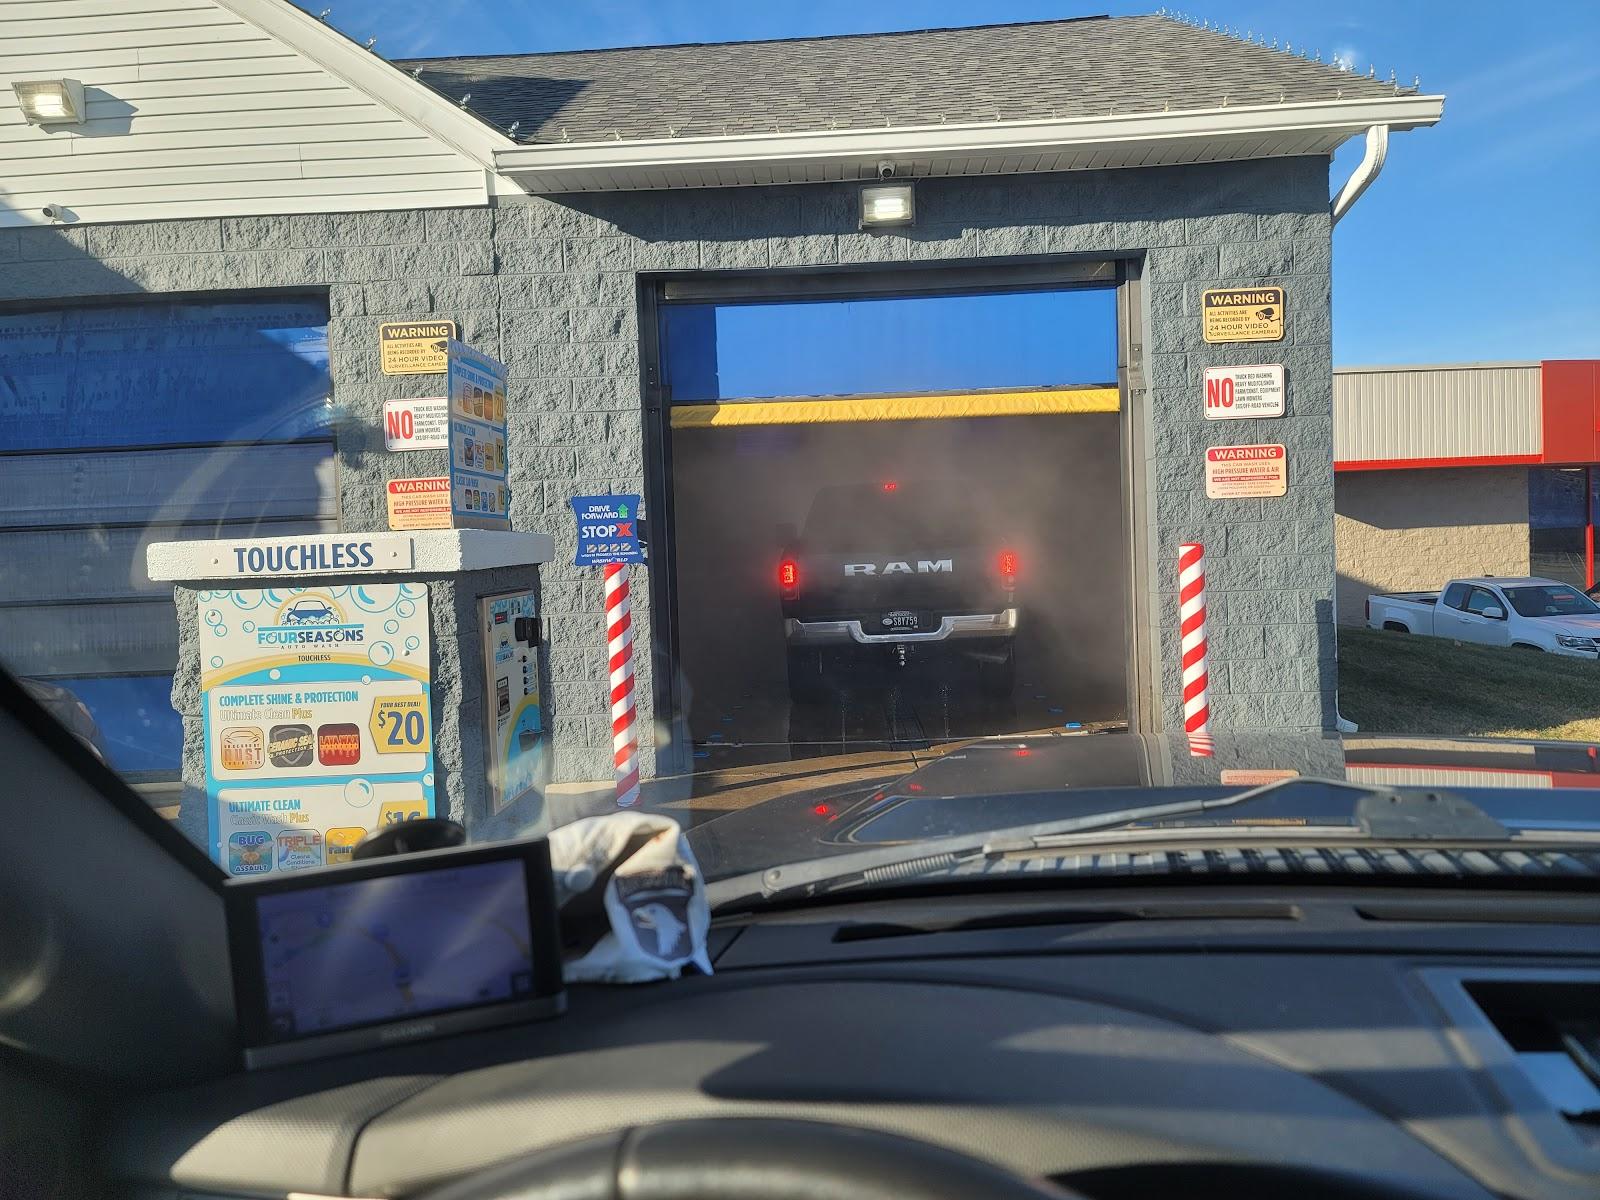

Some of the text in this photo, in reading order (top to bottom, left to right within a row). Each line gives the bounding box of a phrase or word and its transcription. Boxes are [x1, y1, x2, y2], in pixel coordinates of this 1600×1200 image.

[1211, 293, 1275, 305] WARNING
[387, 326, 448, 338] WARNING
[1207, 377, 1234, 408] NO
[387, 410, 413, 440] NO
[1215, 447, 1277, 460] WARNING
[1225, 467, 1249, 475] PRESSURE
[1249, 466, 1266, 474] WATER
[405, 499, 427, 507] PRESSURE
[588, 504, 610, 513] DRIVE
[581, 512, 618, 520] FORWARD
[581, 525, 617, 539] STOP
[234, 542, 374, 573] TOUCHLESS
[845, 559, 952, 577] RAM
[298, 654, 331, 662] TOUCHLESS
[219, 691, 359, 707] COMPLETE SHINE & PROTECTION
[219, 707, 313, 721] Ultimate Clean Plus
[378, 710, 424, 745] $20
[319, 734, 359, 746] LAVA WAX
[224, 748, 262, 761] RUST
[229, 799, 301, 813] ULTIMATE CLEAN
[289, 812, 309, 824] Plus
[238, 835, 265, 846] BUG
[278, 835, 322, 847] TRIPLE
